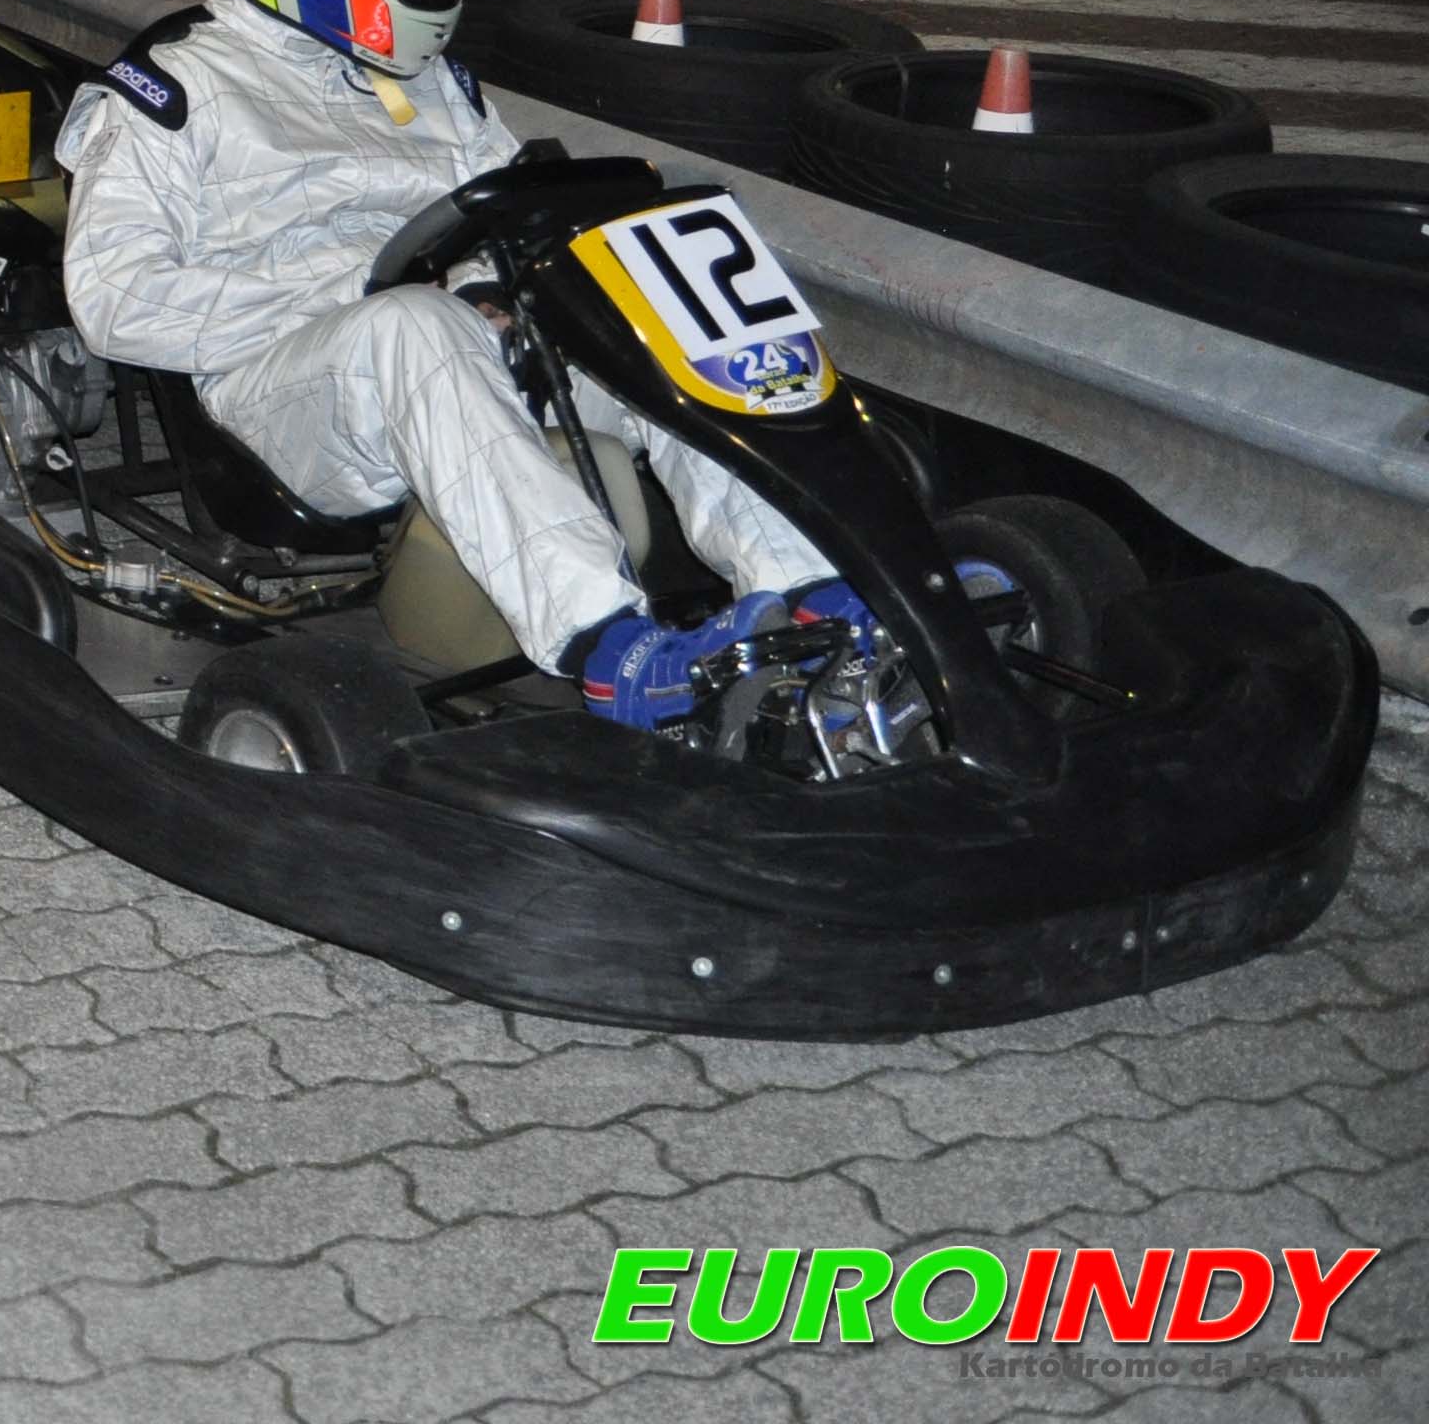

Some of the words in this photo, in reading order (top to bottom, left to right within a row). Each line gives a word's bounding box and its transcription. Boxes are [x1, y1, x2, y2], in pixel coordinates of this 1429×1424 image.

[111, 61, 169, 105] sparco
[630, 209, 798, 342] 12
[733, 342, 789, 381] 24
